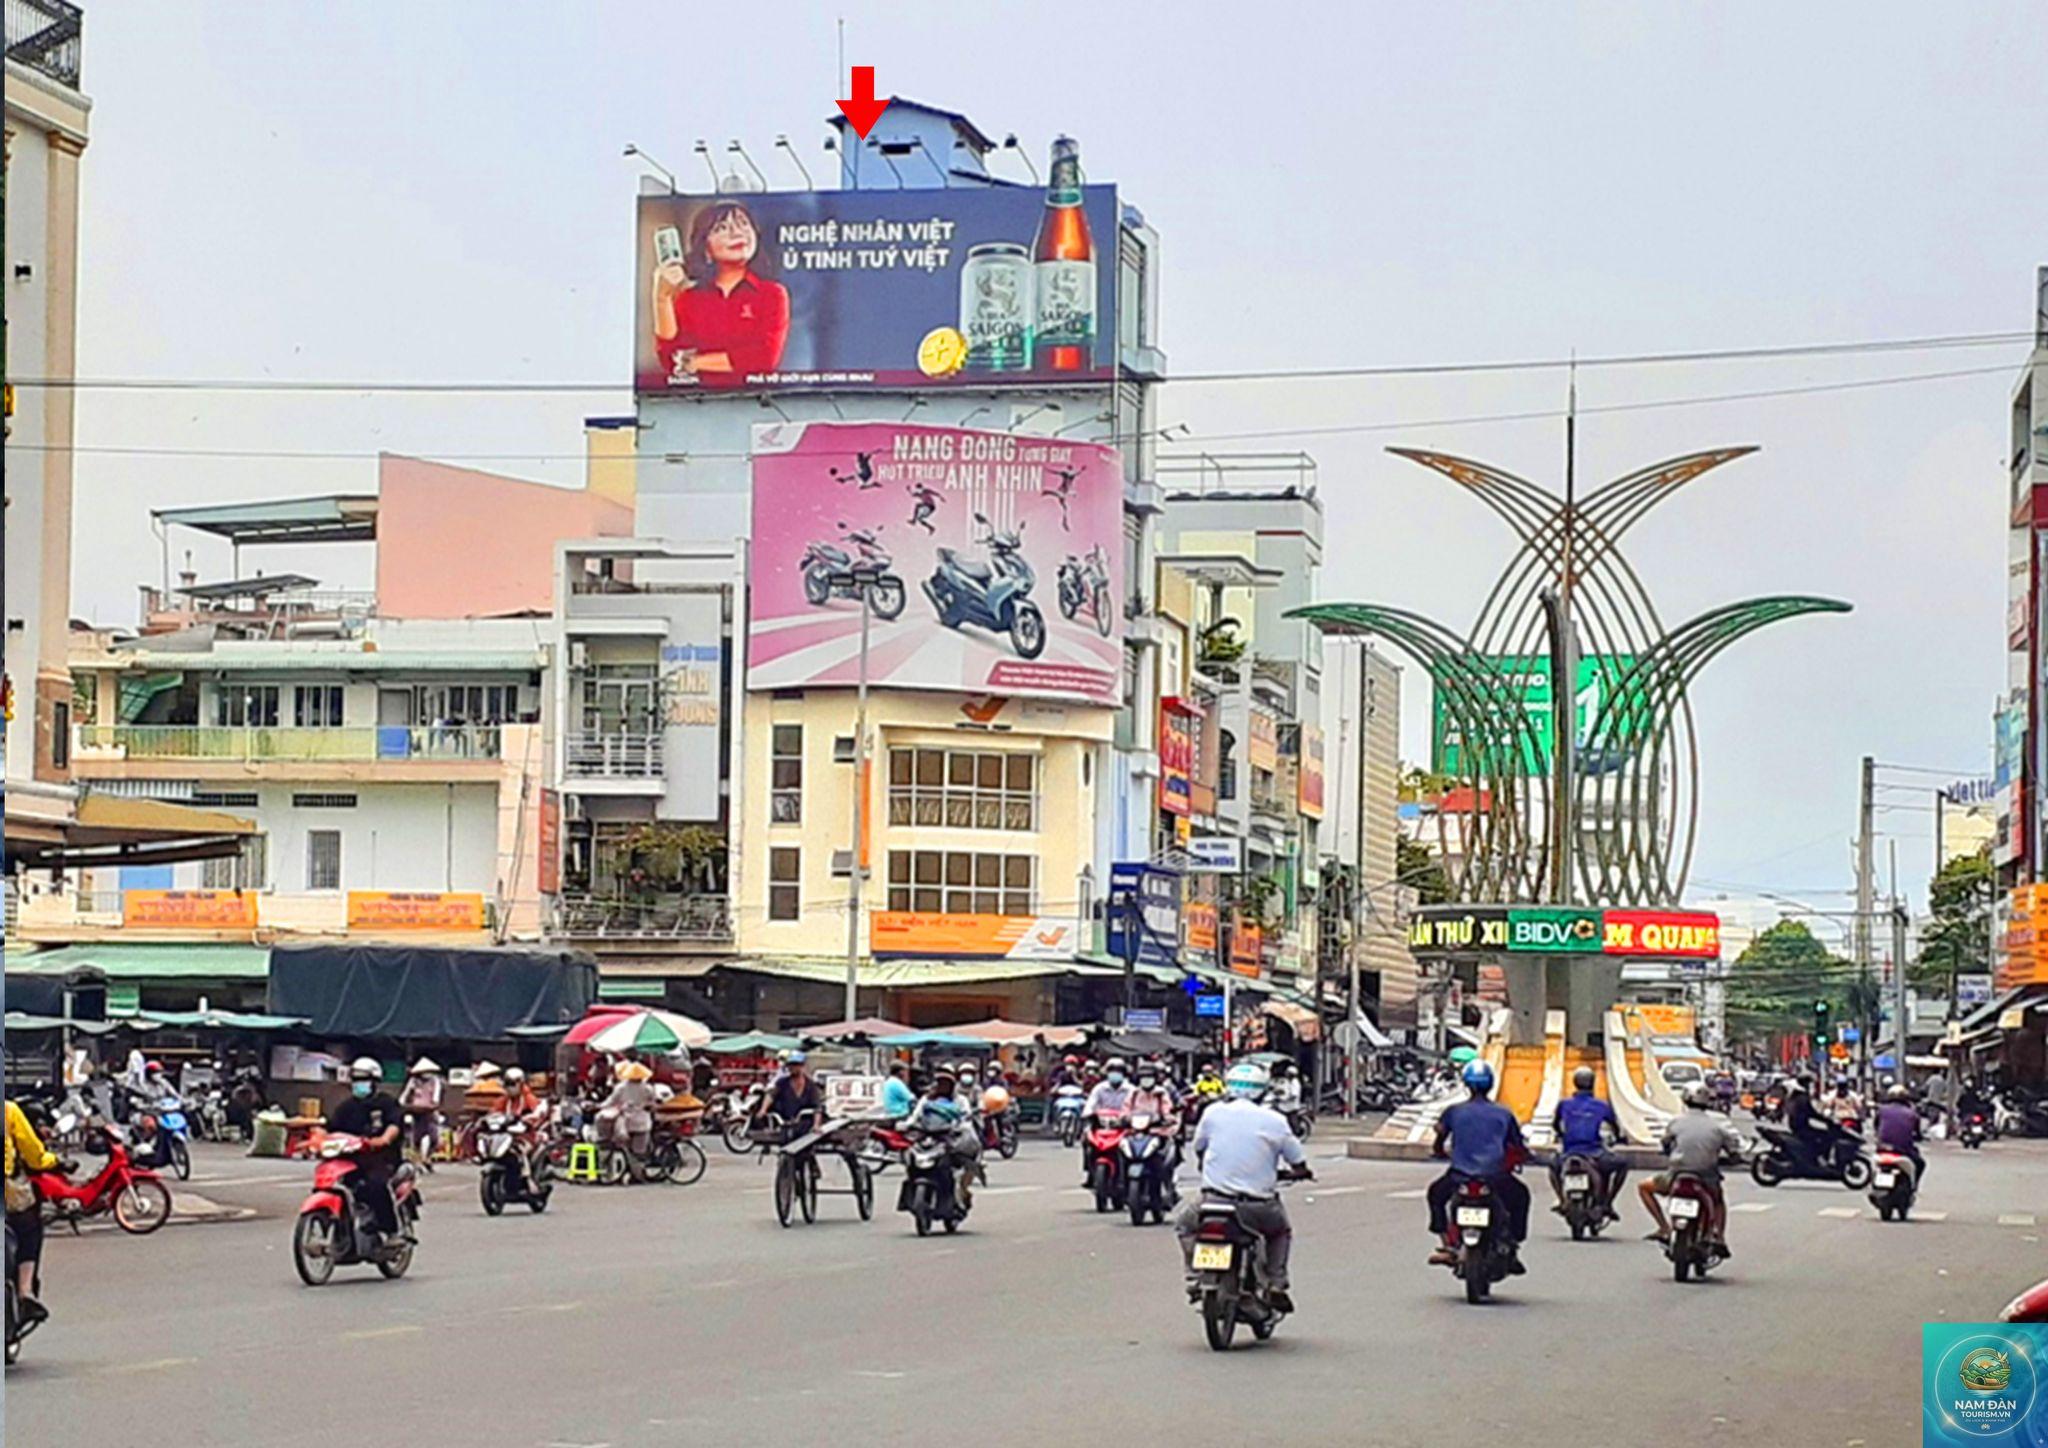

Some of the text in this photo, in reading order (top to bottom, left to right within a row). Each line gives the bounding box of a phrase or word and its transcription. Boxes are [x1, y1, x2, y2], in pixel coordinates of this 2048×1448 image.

[779, 217, 954, 247] NGHỆ NHÂN VIỆT
[803, 251, 851, 269] TINH
[903, 243, 950, 273] VIỆT
[1516, 921, 1574, 944] BIDV
